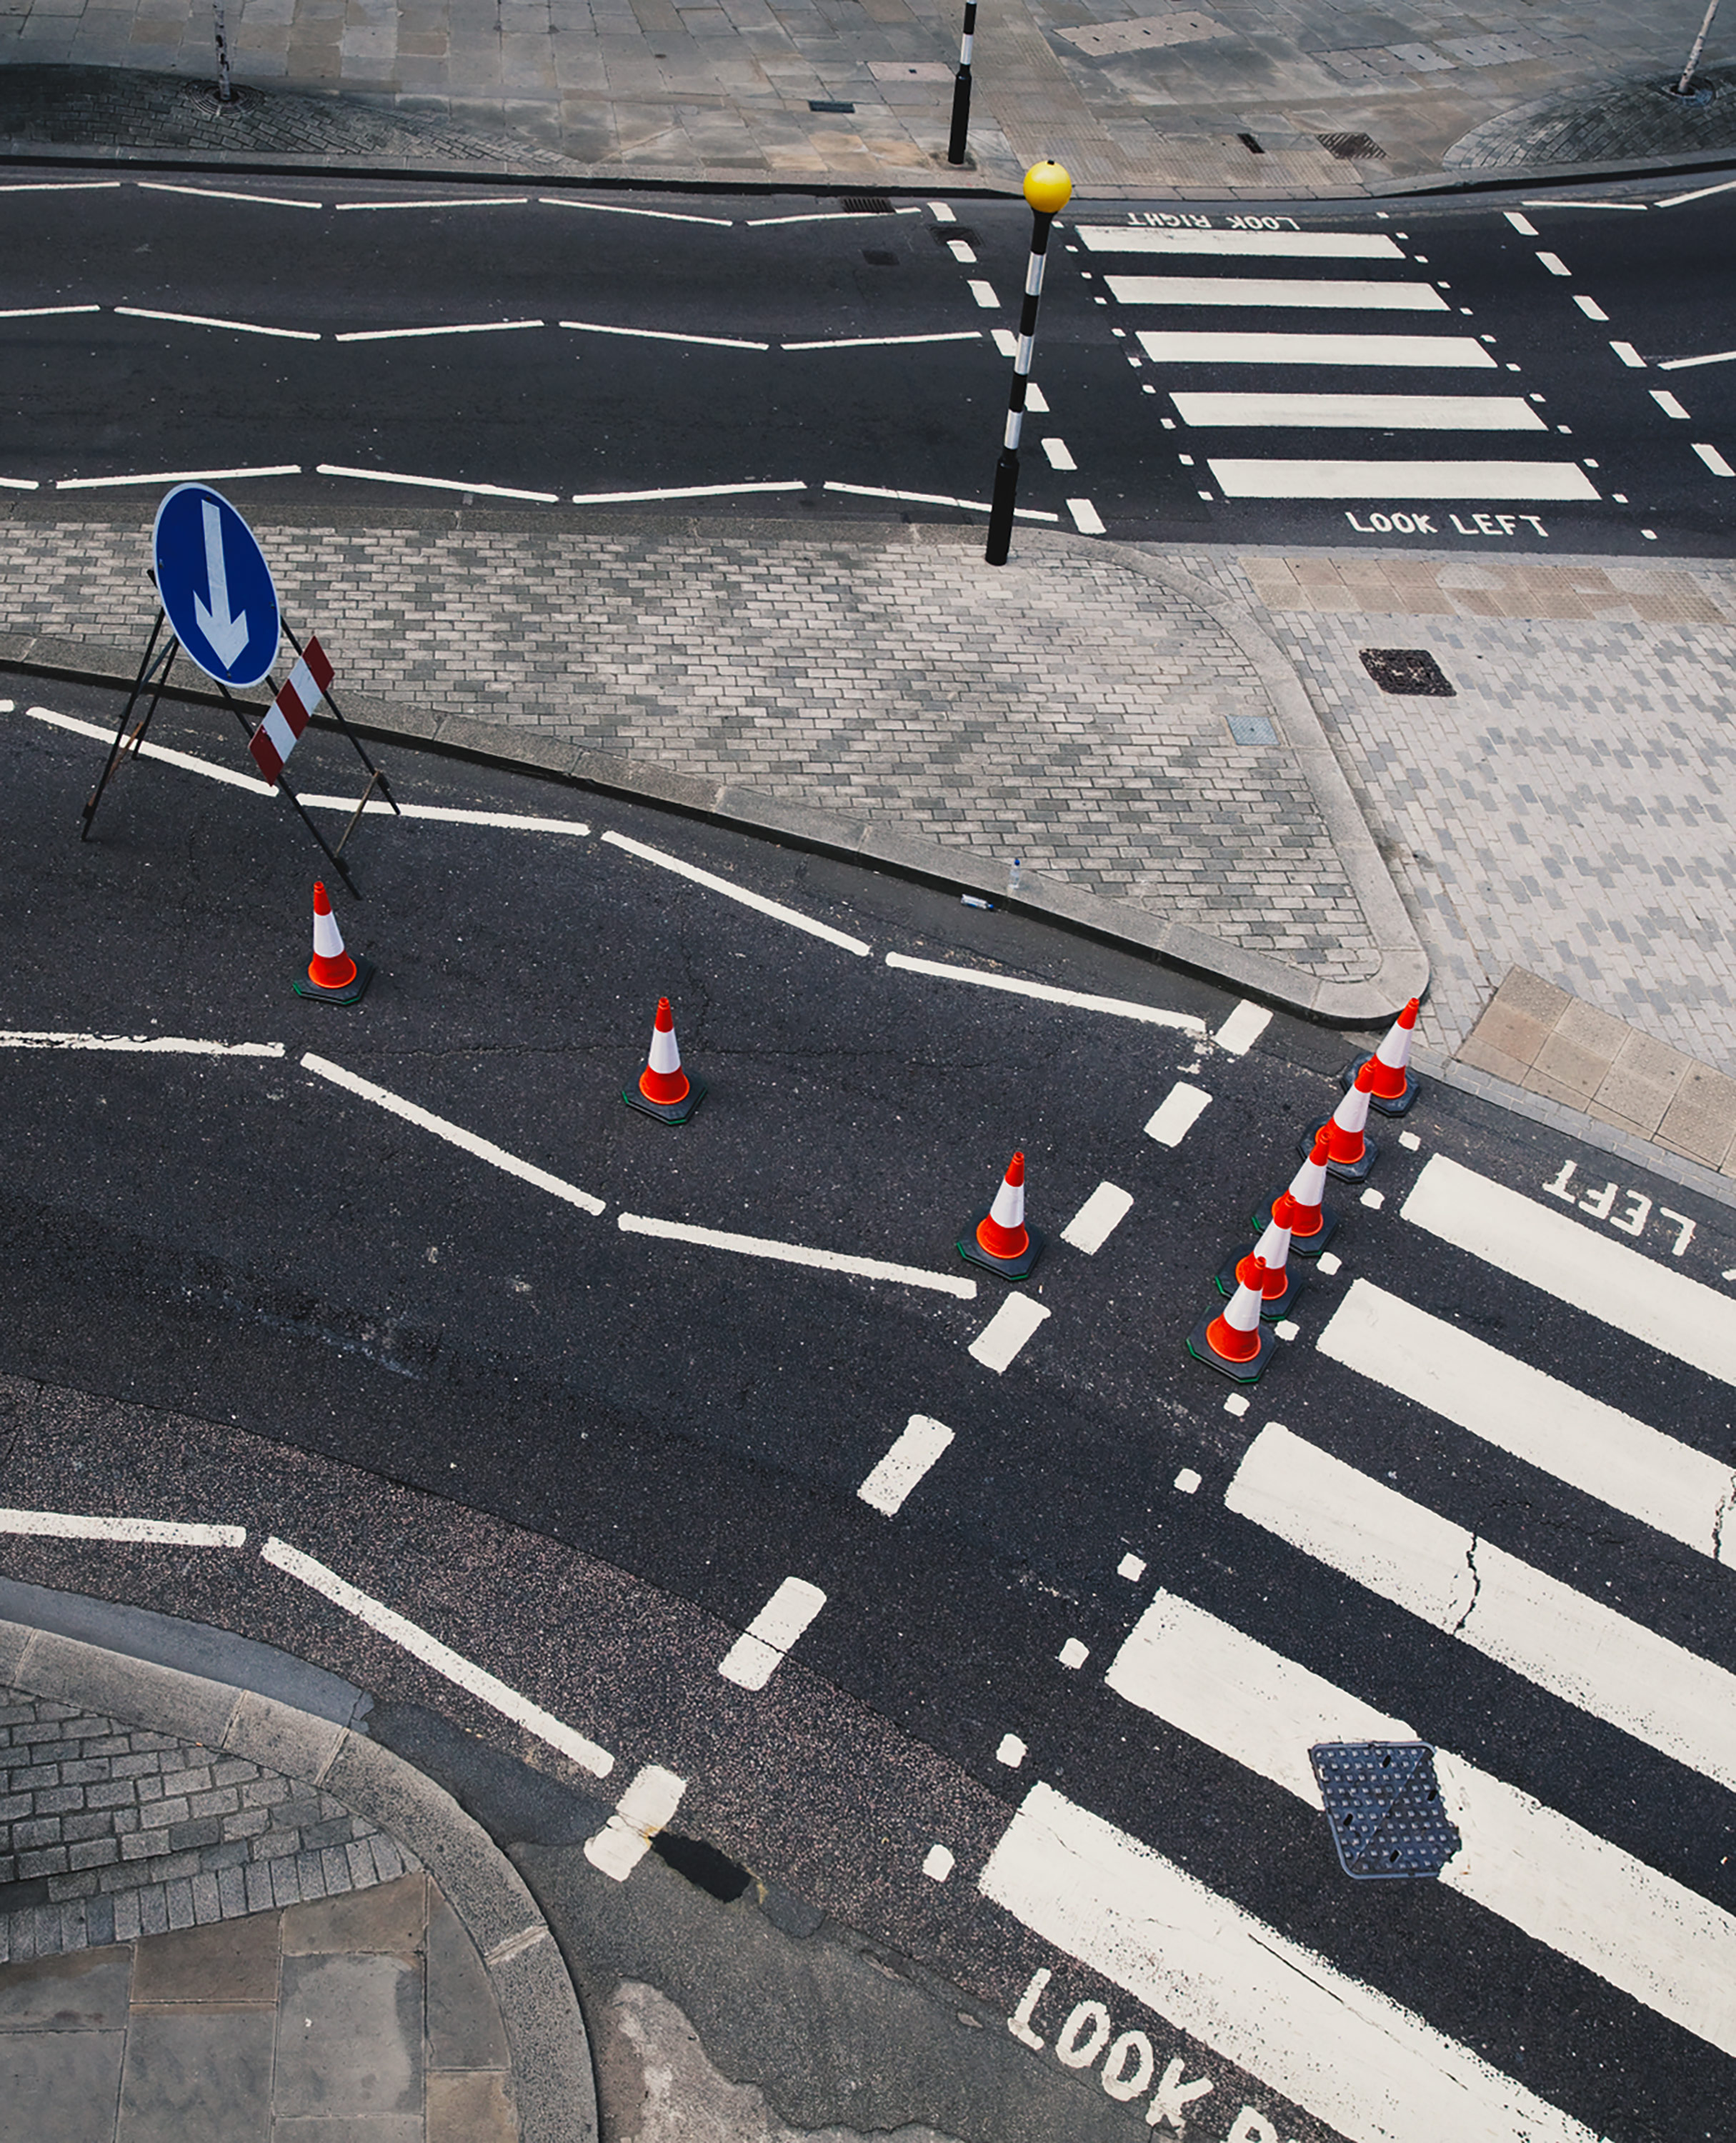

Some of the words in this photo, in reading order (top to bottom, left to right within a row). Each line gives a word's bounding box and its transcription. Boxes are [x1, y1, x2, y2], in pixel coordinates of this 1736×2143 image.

[1127, 212, 1212, 229] RIGHT
[1225, 216, 1301, 231] LOOK
[1345, 511, 1438, 534] LOOK
[1449, 514, 1549, 537] LEFT
[1542, 1159, 1697, 1257] LEFT
[1007, 1967, 1214, 2139] LOOK
